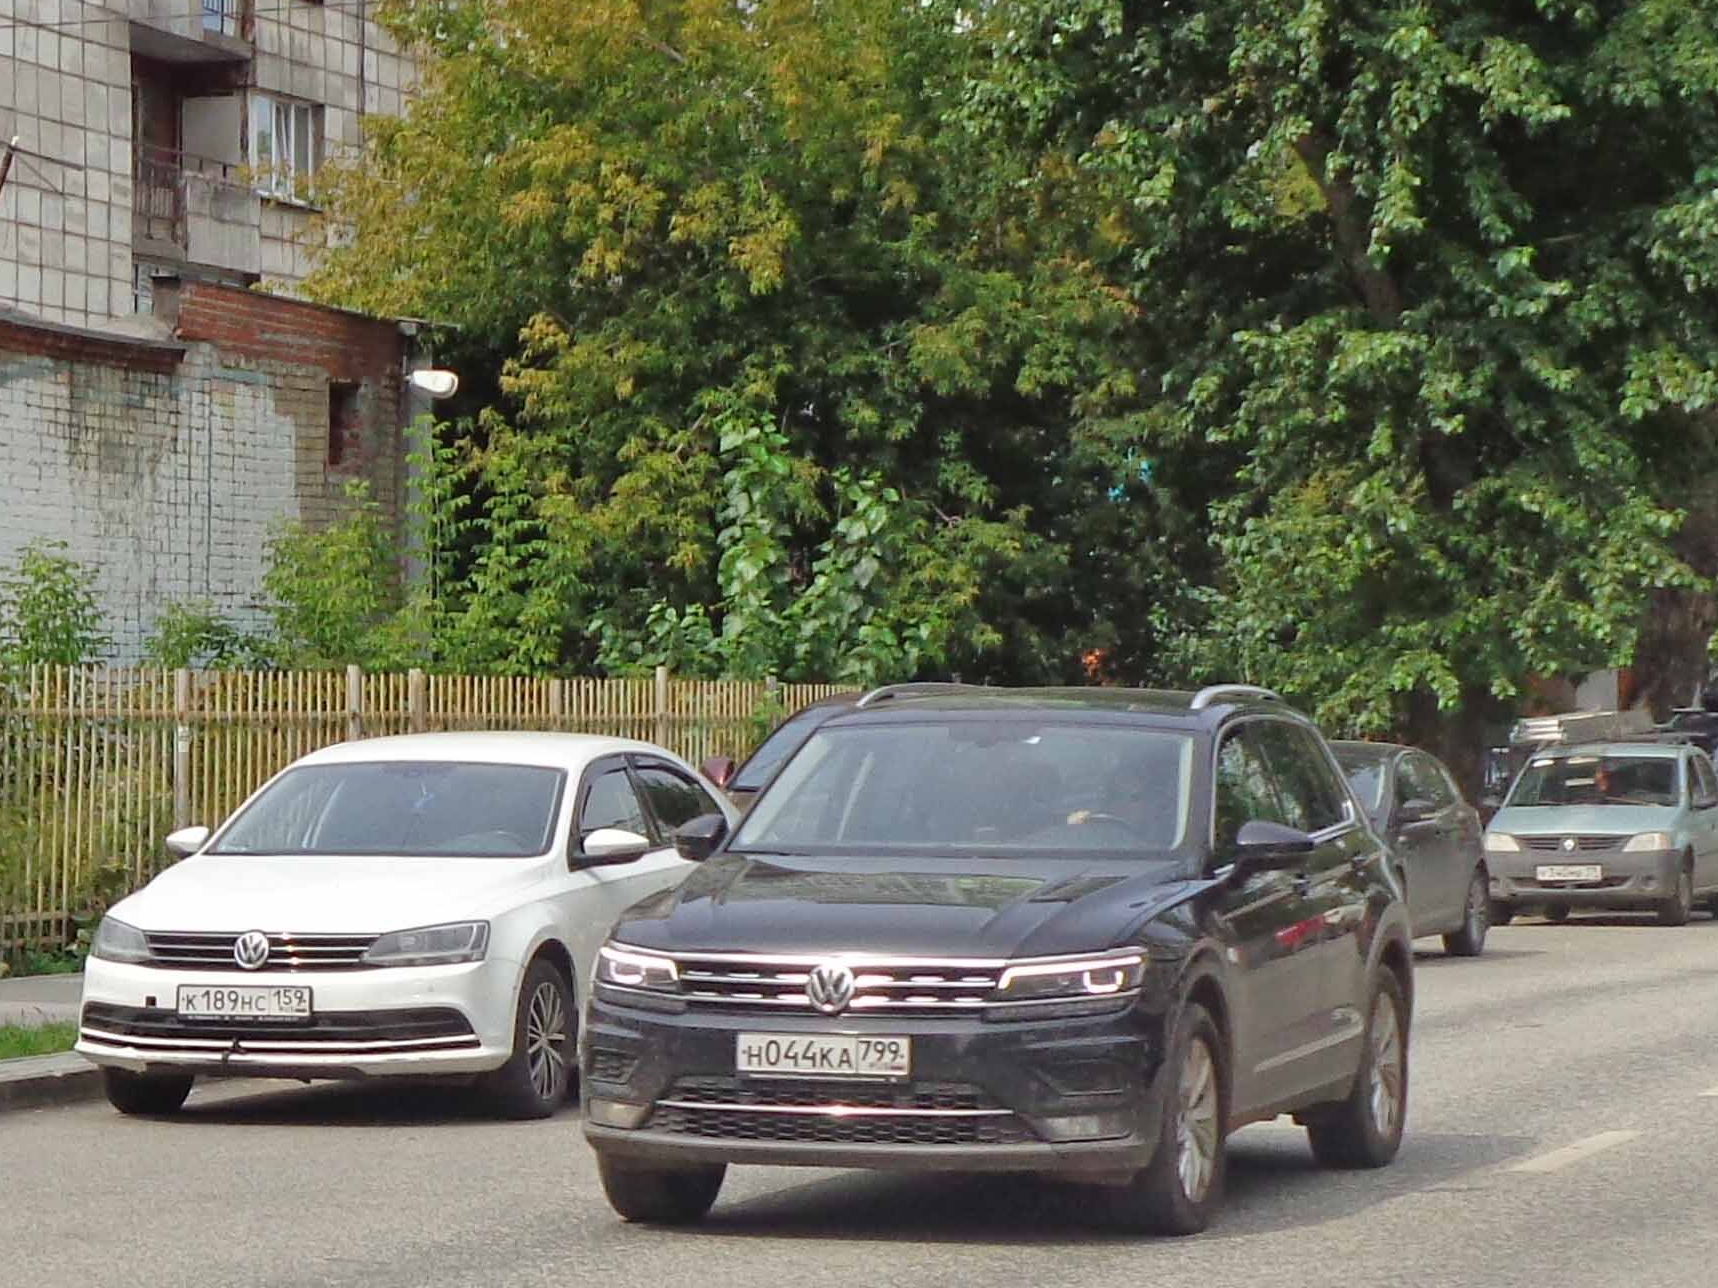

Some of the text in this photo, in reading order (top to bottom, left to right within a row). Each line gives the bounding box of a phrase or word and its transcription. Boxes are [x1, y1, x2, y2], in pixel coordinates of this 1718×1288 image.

[185, 988, 304, 1011] К189НС 159
[747, 1040, 900, 1068] Н044КА 799
